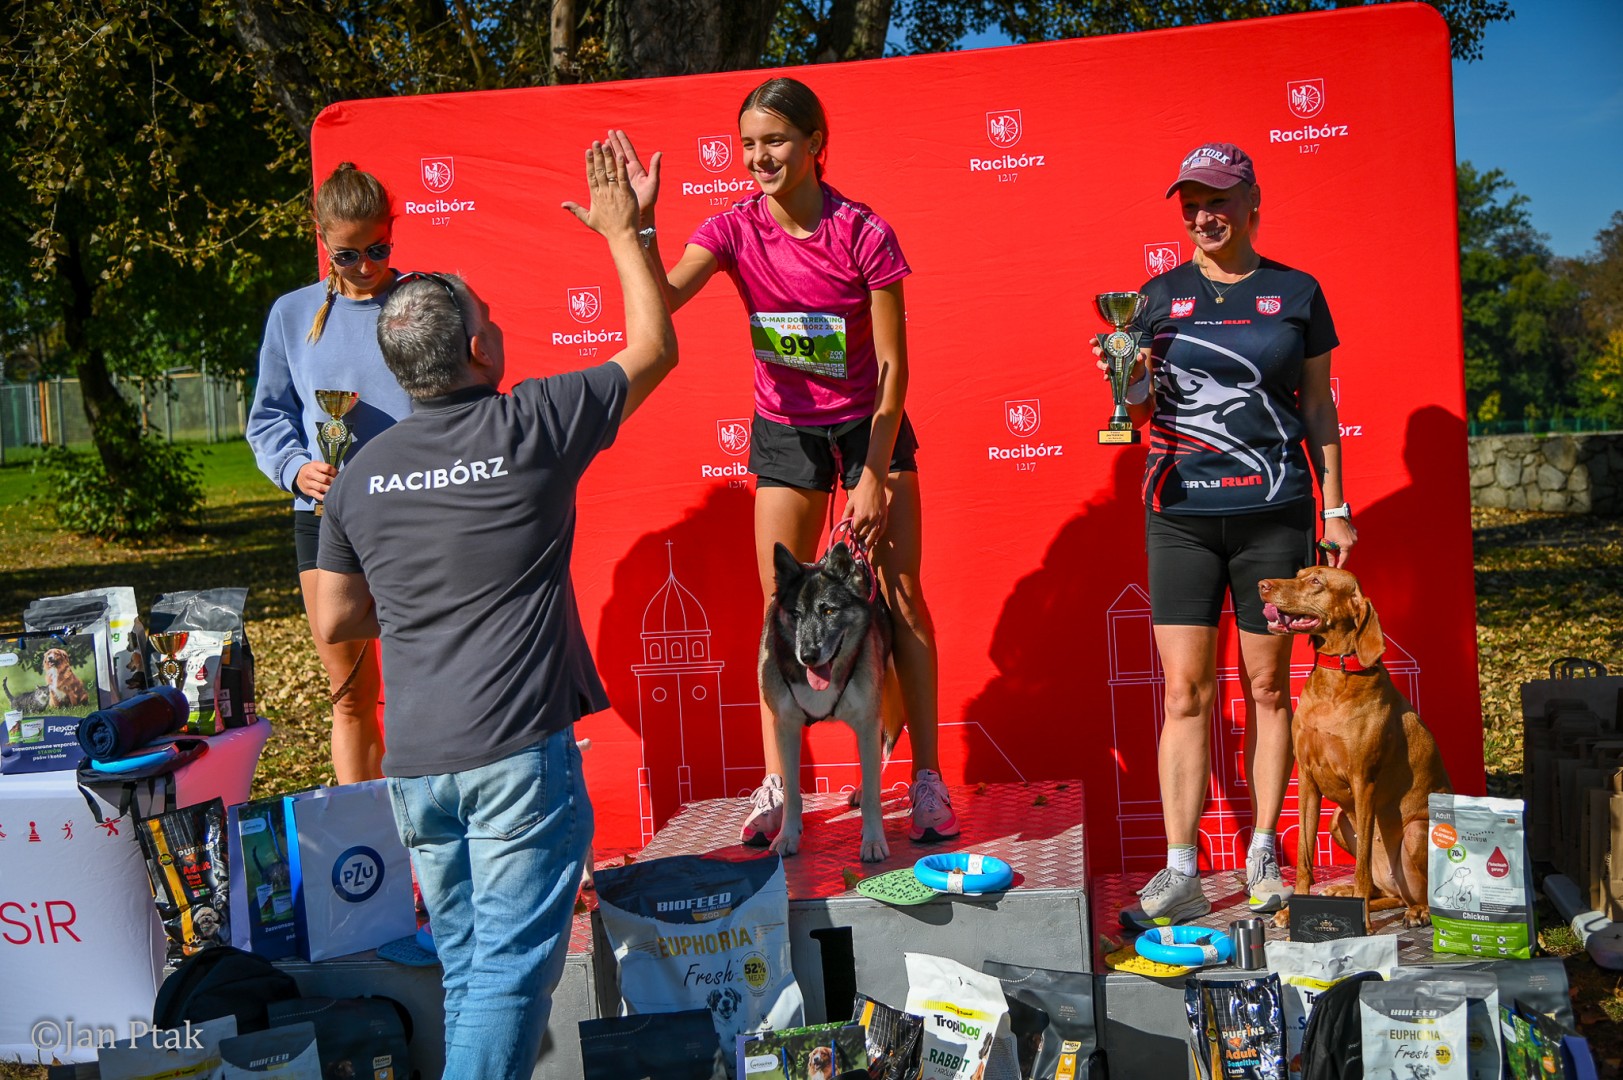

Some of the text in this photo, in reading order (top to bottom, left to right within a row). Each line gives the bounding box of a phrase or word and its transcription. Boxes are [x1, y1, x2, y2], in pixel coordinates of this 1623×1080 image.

[1269, 124, 1348, 143] Racibórz
[1201, 148, 1230, 164] YORK
[1299, 144, 1320, 154] 1217
[970, 154, 1045, 171] Racibórz
[998, 173, 1018, 183] 1217
[682, 179, 754, 196] Racibórz
[405, 199, 476, 215] Racibórz
[709, 197, 729, 207] 1217
[431, 217, 450, 226] 1217
[552, 330, 623, 345] Racibórz
[578, 347, 598, 357] 1217
[780, 336, 815, 356] 99
[988, 443, 1063, 460] Racibórz
[701, 462, 748, 477] Racib
[1017, 462, 1036, 472] 1217
[369, 456, 508, 495] RACIBÓRZ
[344, 862, 373, 887] PZU
[657, 893, 731, 912] BIOFEED
[1462, 912, 1490, 921] Chicken
[657, 928, 753, 959] EUPHORIA
[683, 960, 734, 987] Fresh
[744, 962, 766, 974] 52%
[934, 1014, 980, 1040] TropiDog
[1222, 1026, 1265, 1039] PUFFINS
[1226, 1048, 1257, 1060] Adult
[1394, 1044, 1429, 1059] Fresh
[929, 1048, 970, 1073] RABBIT
[1227, 1059, 1260, 1067] Sensitive
